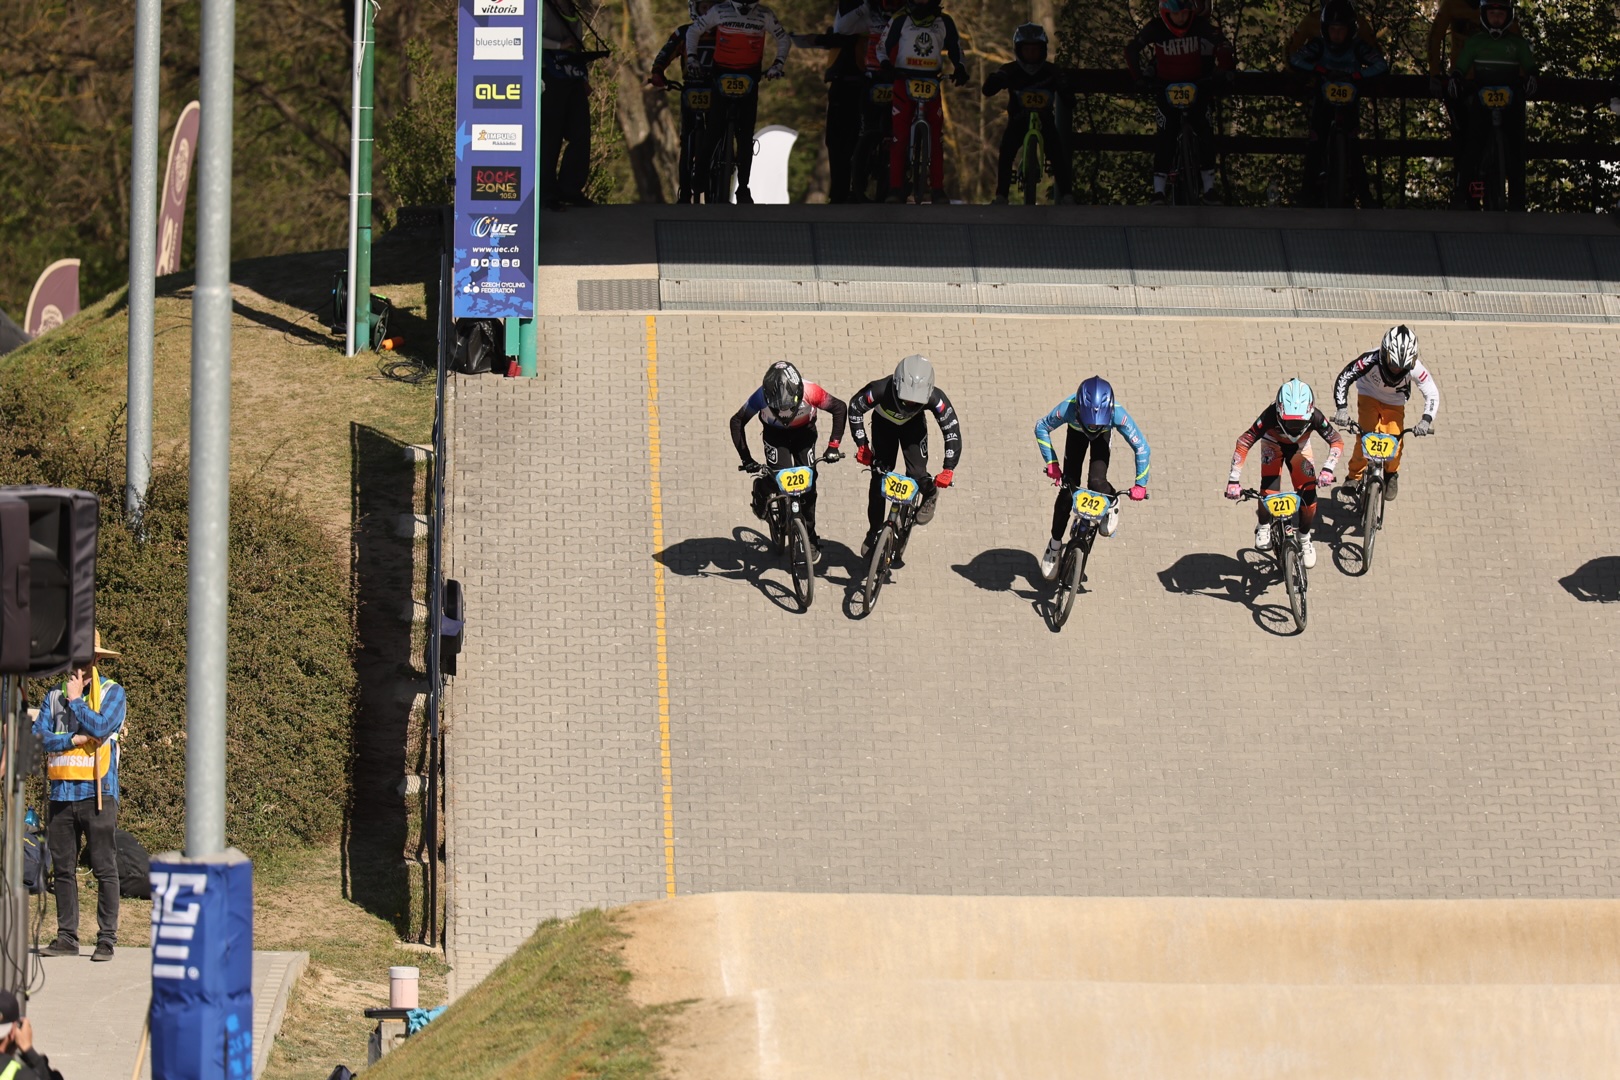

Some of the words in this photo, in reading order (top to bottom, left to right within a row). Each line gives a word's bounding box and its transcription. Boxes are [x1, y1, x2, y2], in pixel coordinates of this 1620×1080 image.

[481, 5, 517, 13] vittoria
[476, 38, 513, 47] bluestyle
[1162, 36, 1199, 55] LATVIA
[726, 80, 744, 90] 259
[914, 83, 931, 94] 218
[1330, 88, 1348, 98] 246
[1487, 93, 1504, 102] 237
[691, 95, 709, 105] 253
[1026, 95, 1044, 104] 243
[487, 132, 517, 140] IMPULS
[476, 170, 517, 183] ROCK
[476, 183, 517, 193] ZONE
[491, 224, 518, 233] UEC
[1371, 441, 1388, 452] 257
[786, 474, 805, 487] 228
[1081, 497, 1100, 511] 242
[1273, 500, 1290, 512] 221
